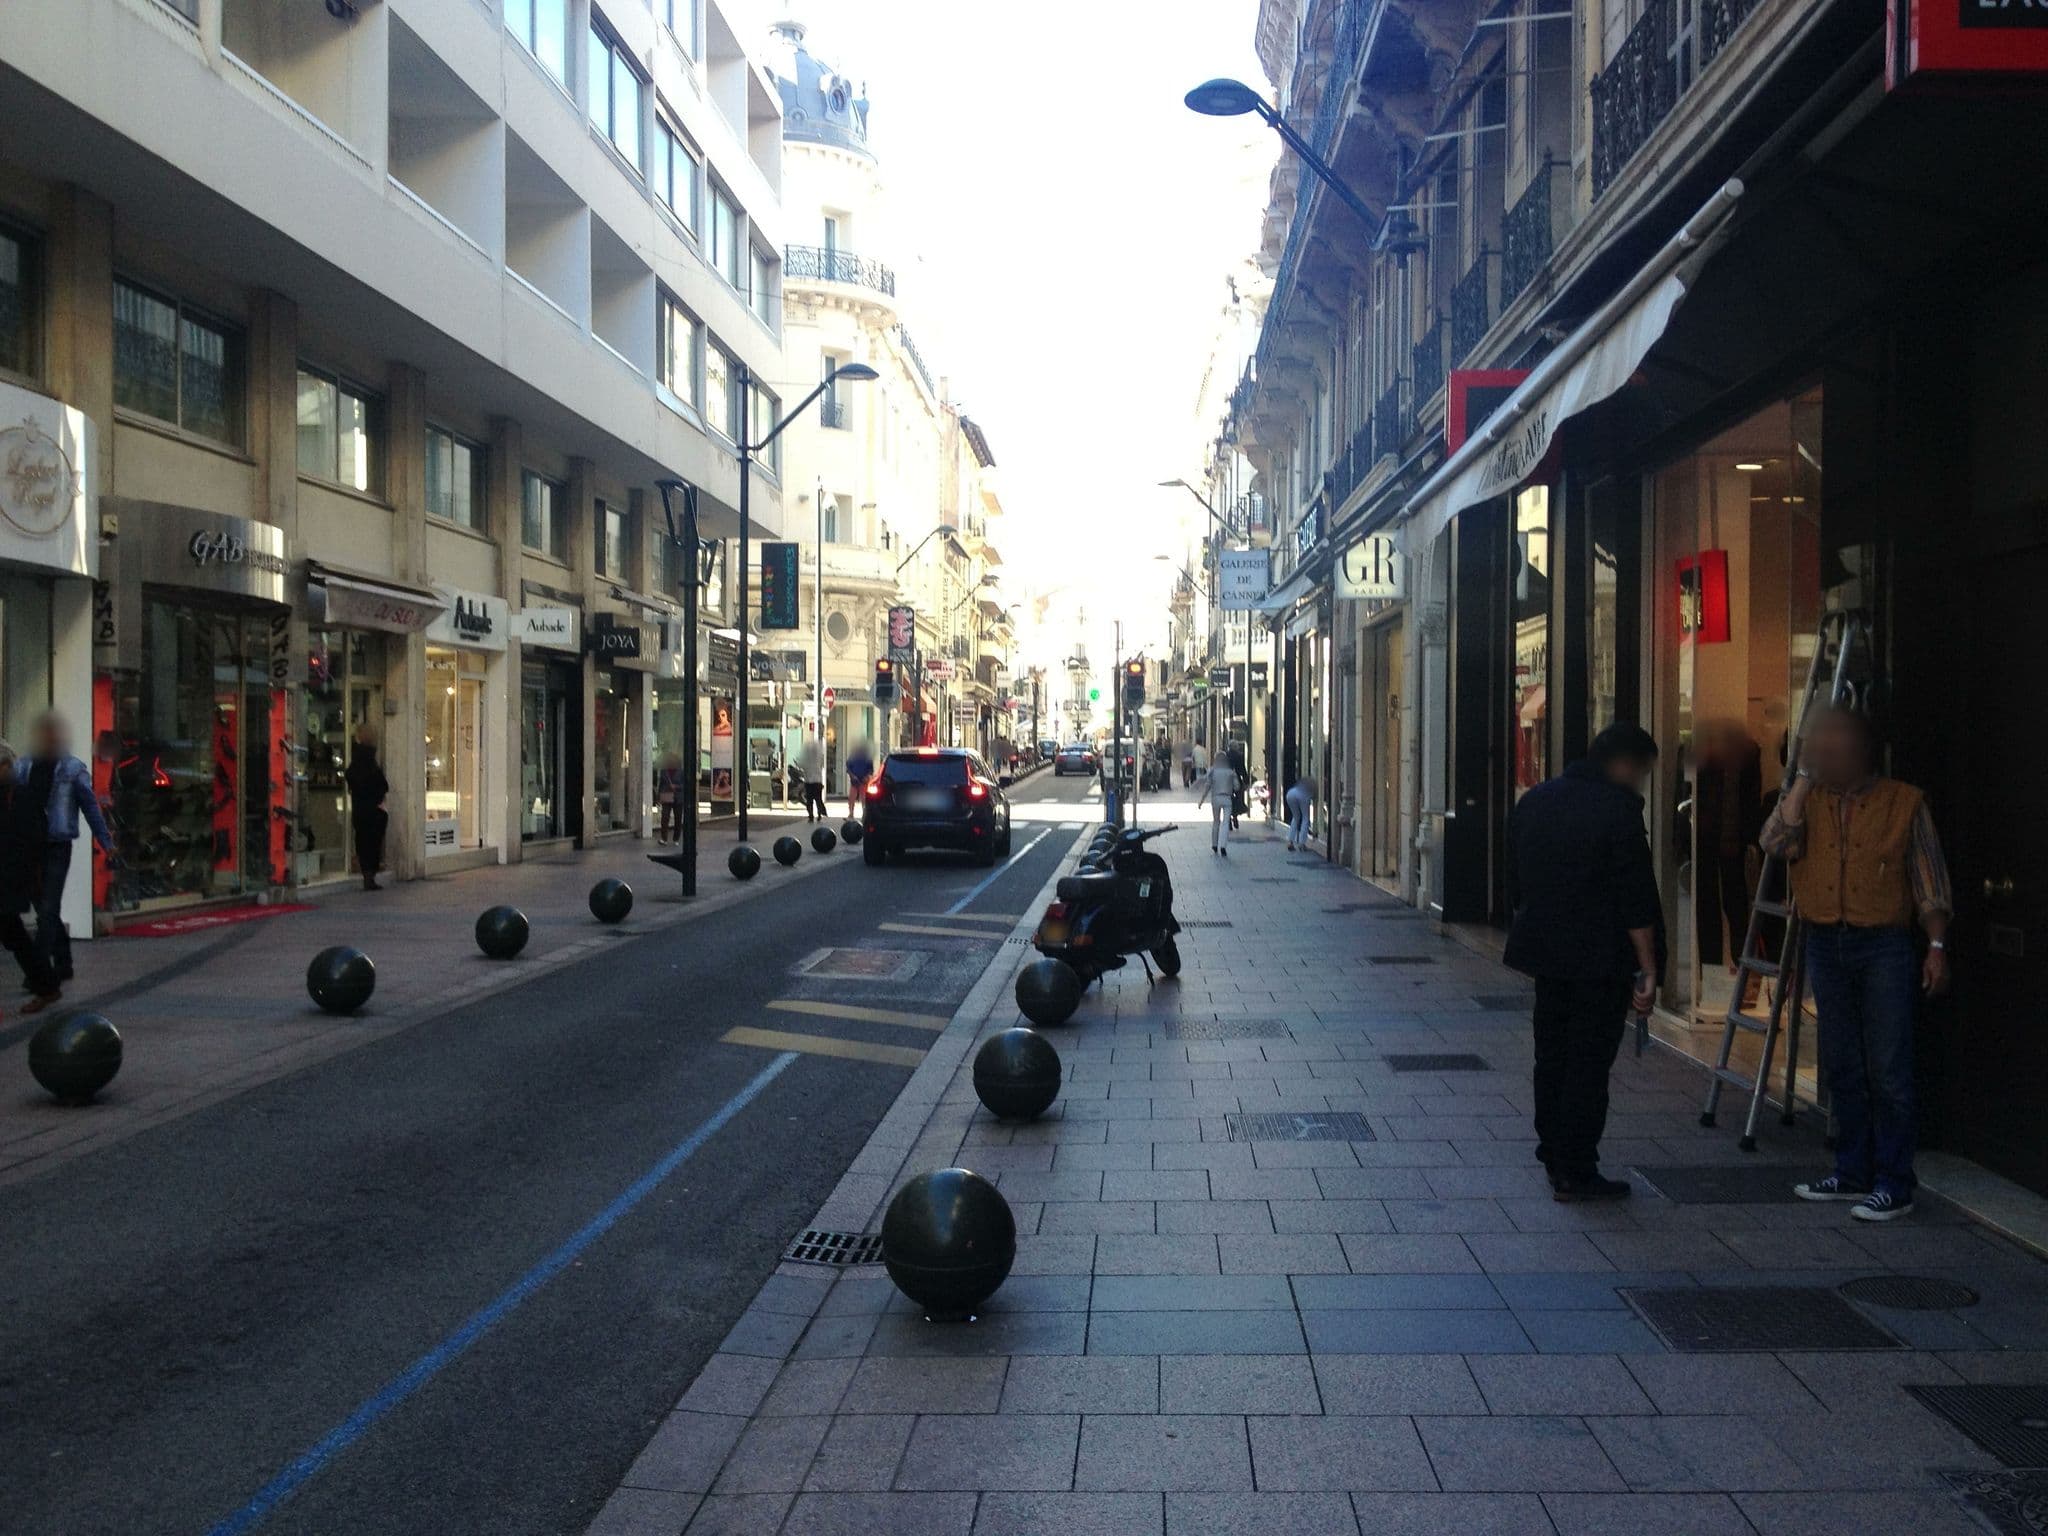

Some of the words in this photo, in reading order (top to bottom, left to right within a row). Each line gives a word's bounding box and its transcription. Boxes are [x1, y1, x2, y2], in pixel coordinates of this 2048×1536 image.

[190, 530, 244, 567] GAB
[526, 618, 566, 633] Aubade
[602, 634, 635, 650] JOYA
